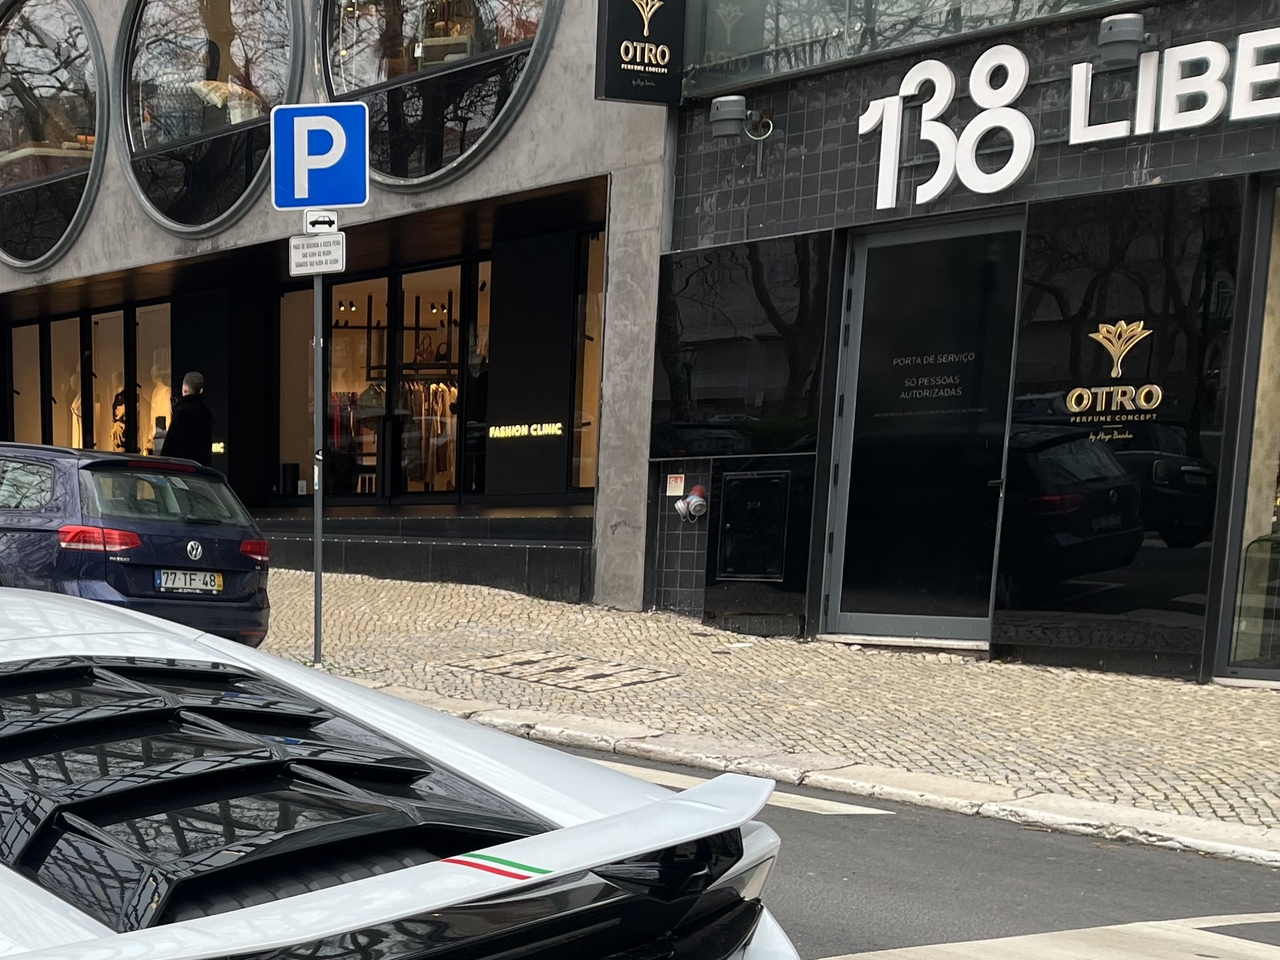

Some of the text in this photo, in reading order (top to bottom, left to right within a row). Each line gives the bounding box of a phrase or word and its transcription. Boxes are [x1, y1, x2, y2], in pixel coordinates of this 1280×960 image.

[620, 40, 670, 66] OTRO
[621, 64, 668, 74] PERFUME CONCEPT
[1069, 28, 1280, 146] LIBE
[858, 44, 1035, 210] 138
[294, 115, 347, 199] P
[892, 352, 975, 366] PORTA DE SERVIÇO
[918, 375, 960, 386] PESSOAS
[899, 387, 962, 399] AUTORIZADAS
[1066, 384, 1162, 413] OTRO
[1070, 413, 1157, 423] PERFUME CONCEPT
[489, 422, 563, 438] FASHION CLINIC
